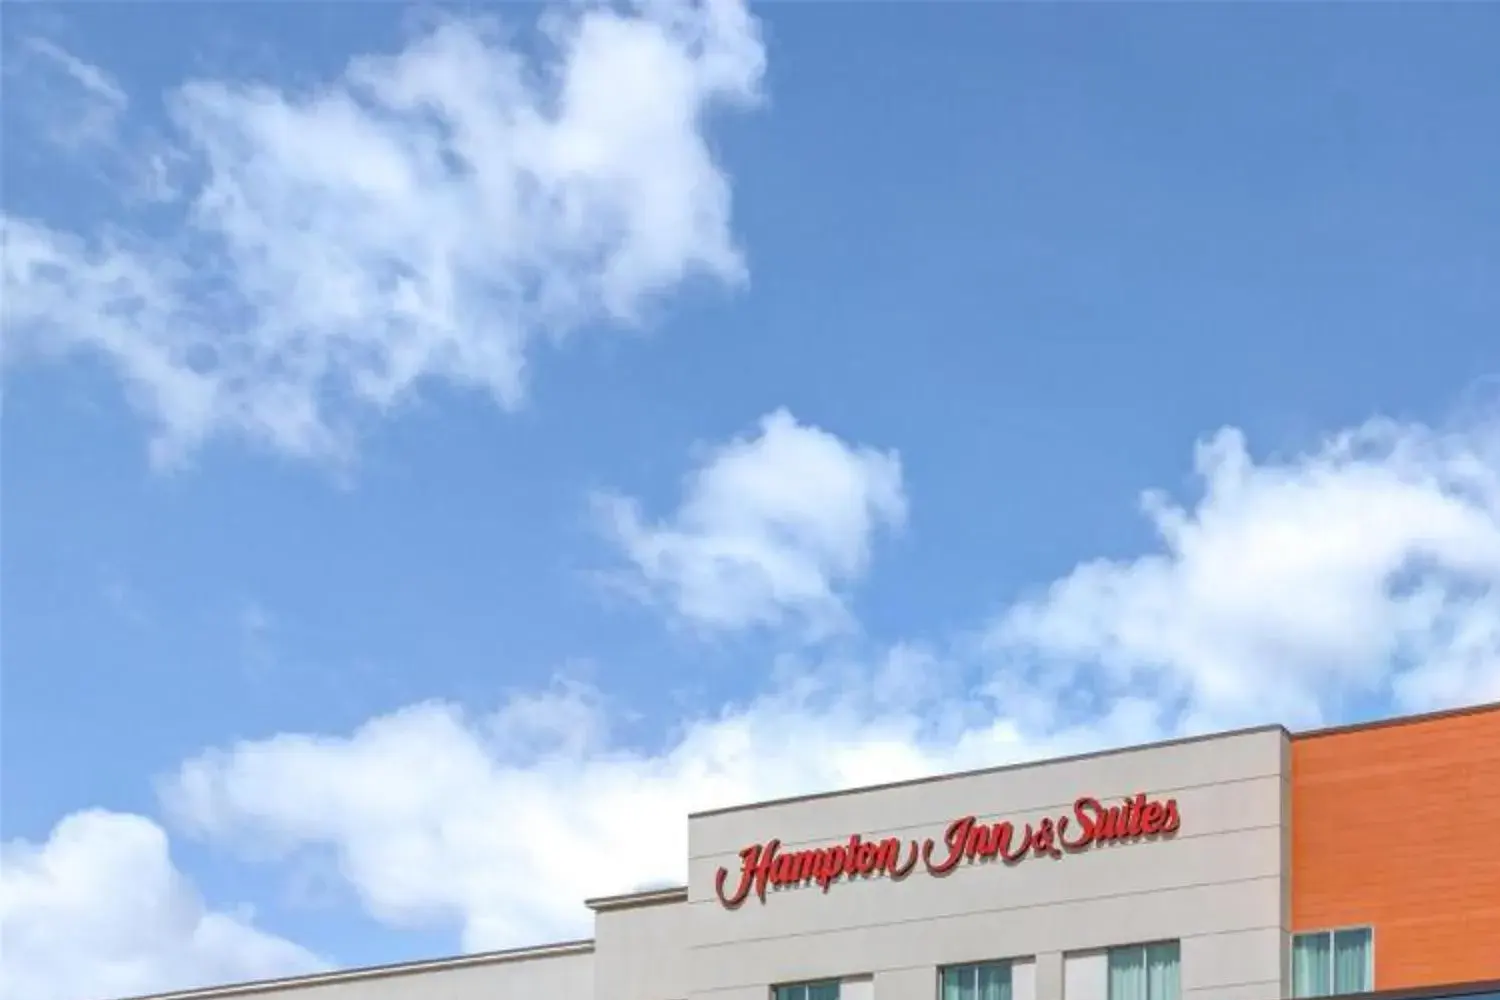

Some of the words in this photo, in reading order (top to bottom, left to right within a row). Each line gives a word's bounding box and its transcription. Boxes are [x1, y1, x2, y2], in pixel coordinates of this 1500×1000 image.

[715, 834, 918, 909] Hampton
[922, 816, 1032, 875] Inn
[1031, 818, 1062, 859] &
[1058, 793, 1180, 851] Suites
